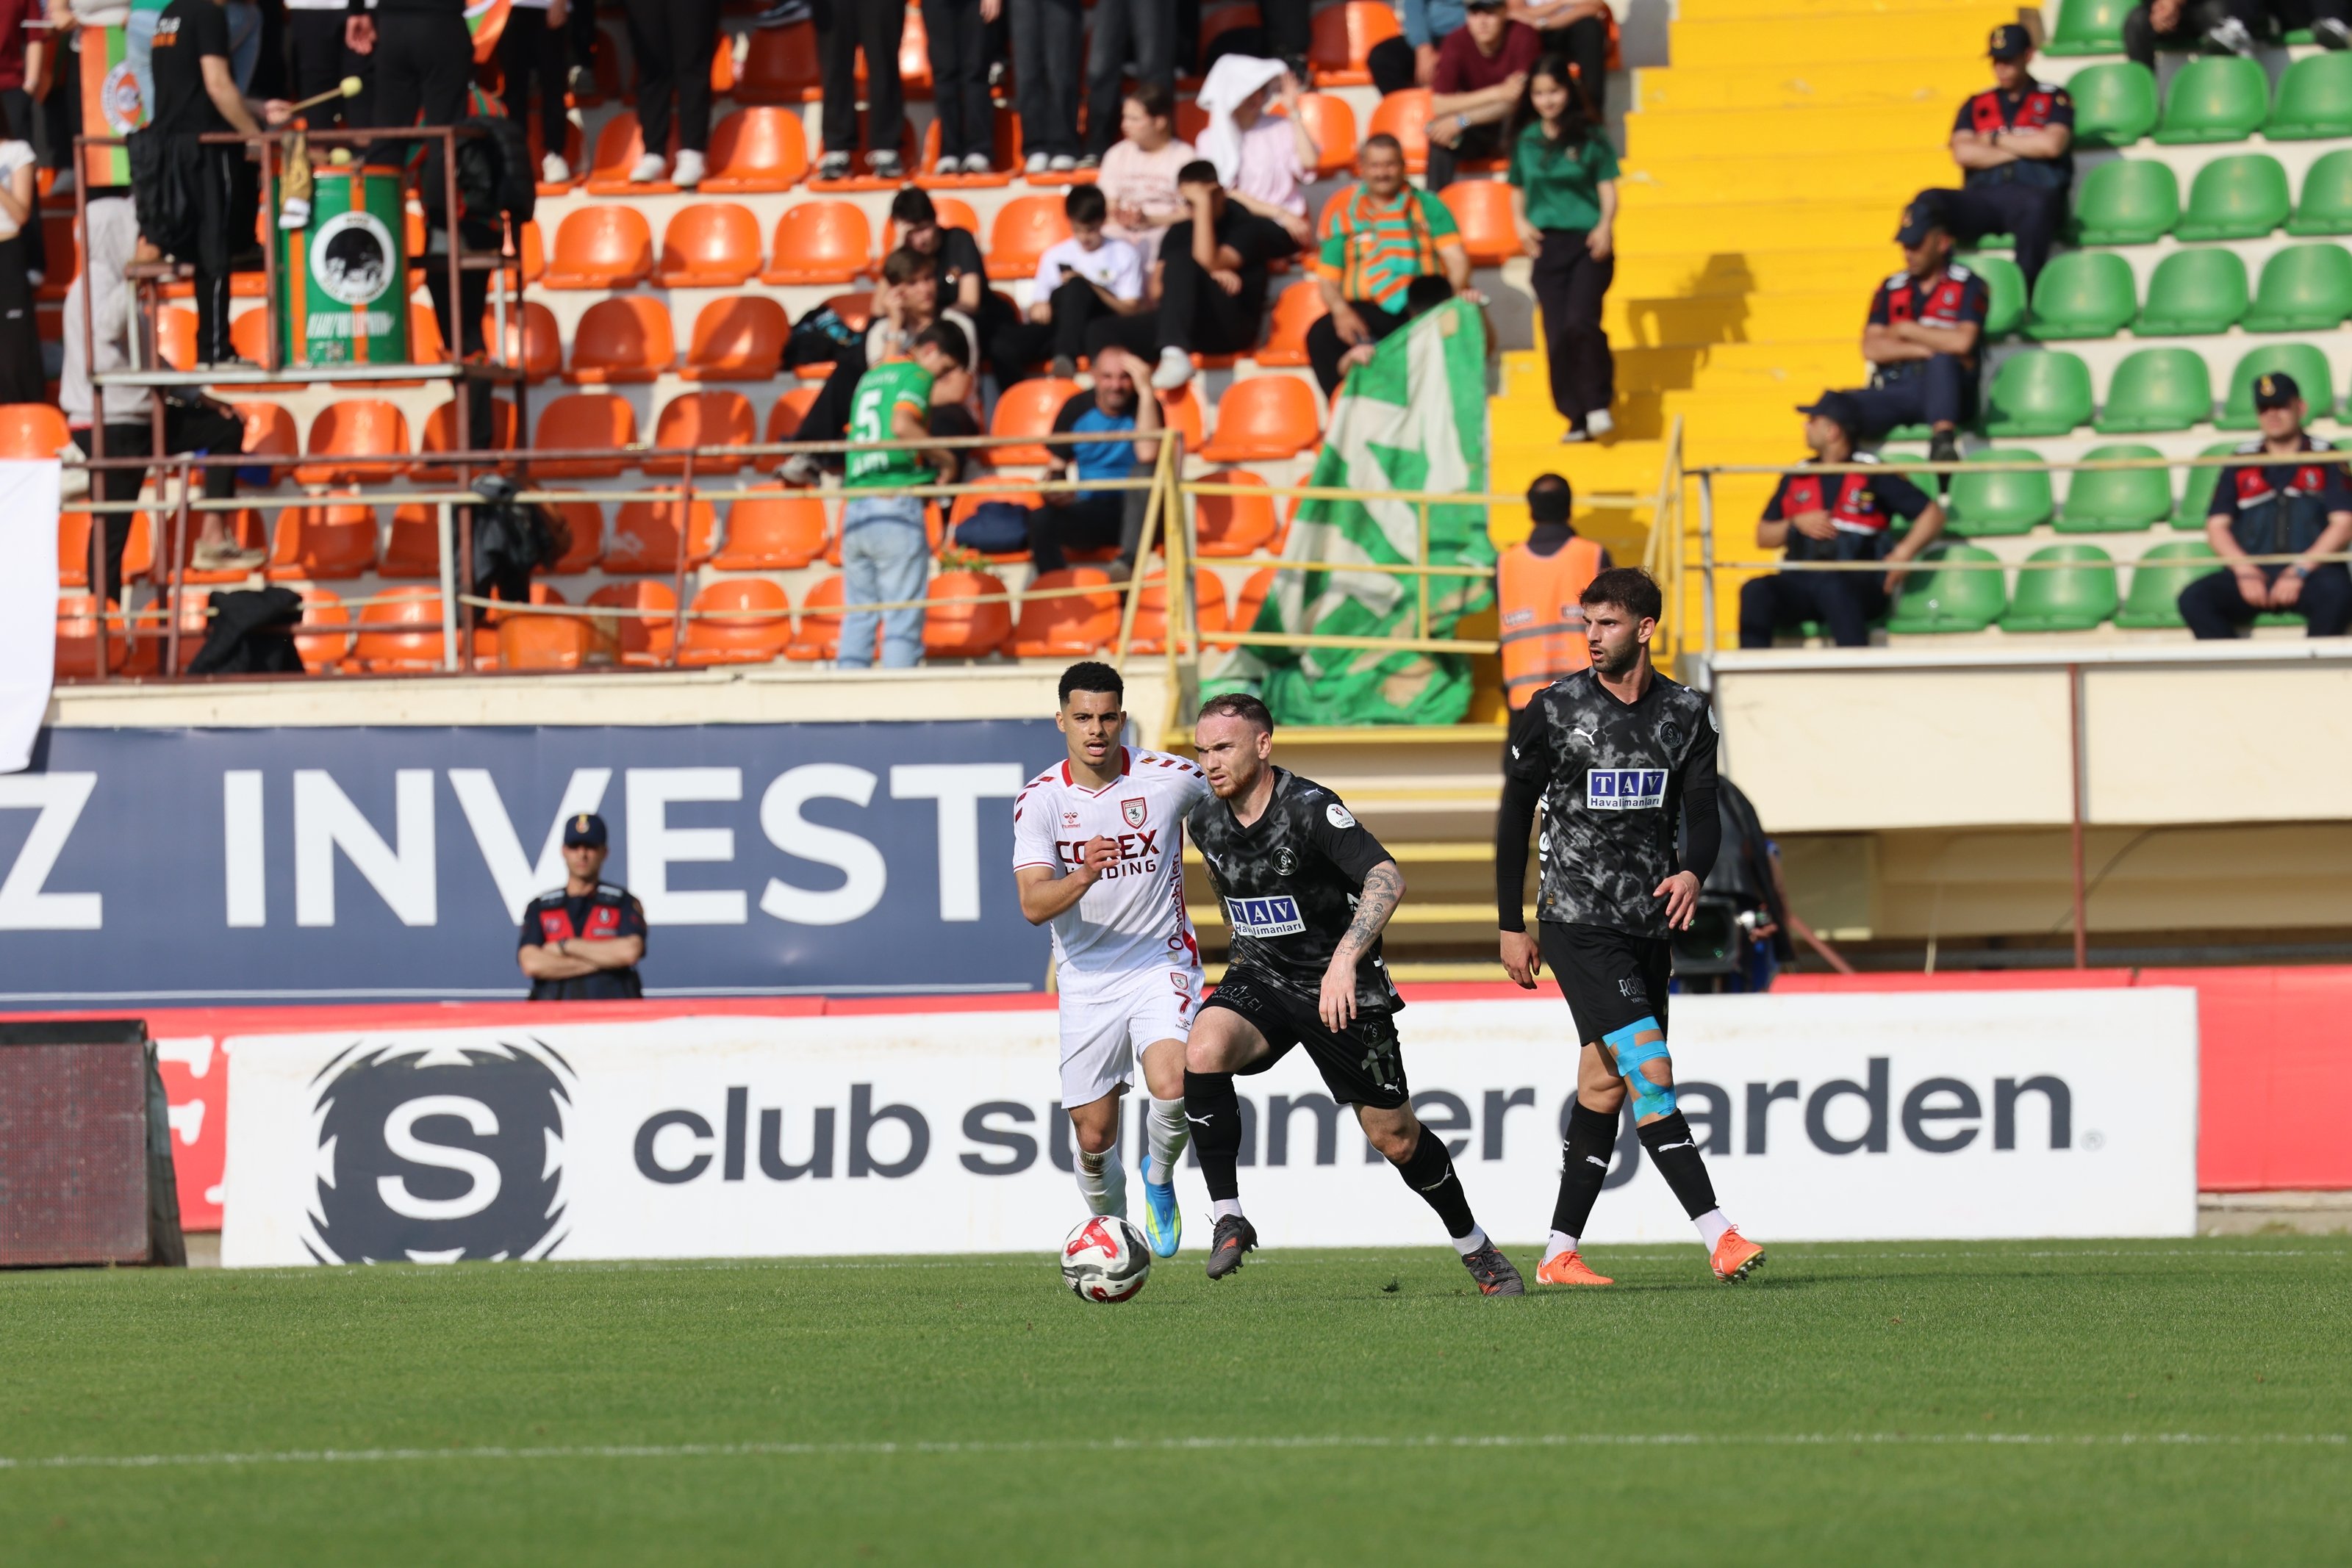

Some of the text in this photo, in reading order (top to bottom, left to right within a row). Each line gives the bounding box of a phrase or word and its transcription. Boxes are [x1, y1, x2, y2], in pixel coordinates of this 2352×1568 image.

[855, 388, 882, 445] 5
[1591, 797, 1660, 808] Havalimanları
[1595, 775, 1660, 794] TAV
[224, 763, 1023, 927] INVEST
[1232, 902, 1288, 922] TAV
[1174, 990, 1191, 1014] 7
[1361, 1037, 1396, 1087] 17
[377, 1096, 501, 1220] S
[634, 1083, 931, 1184] club
